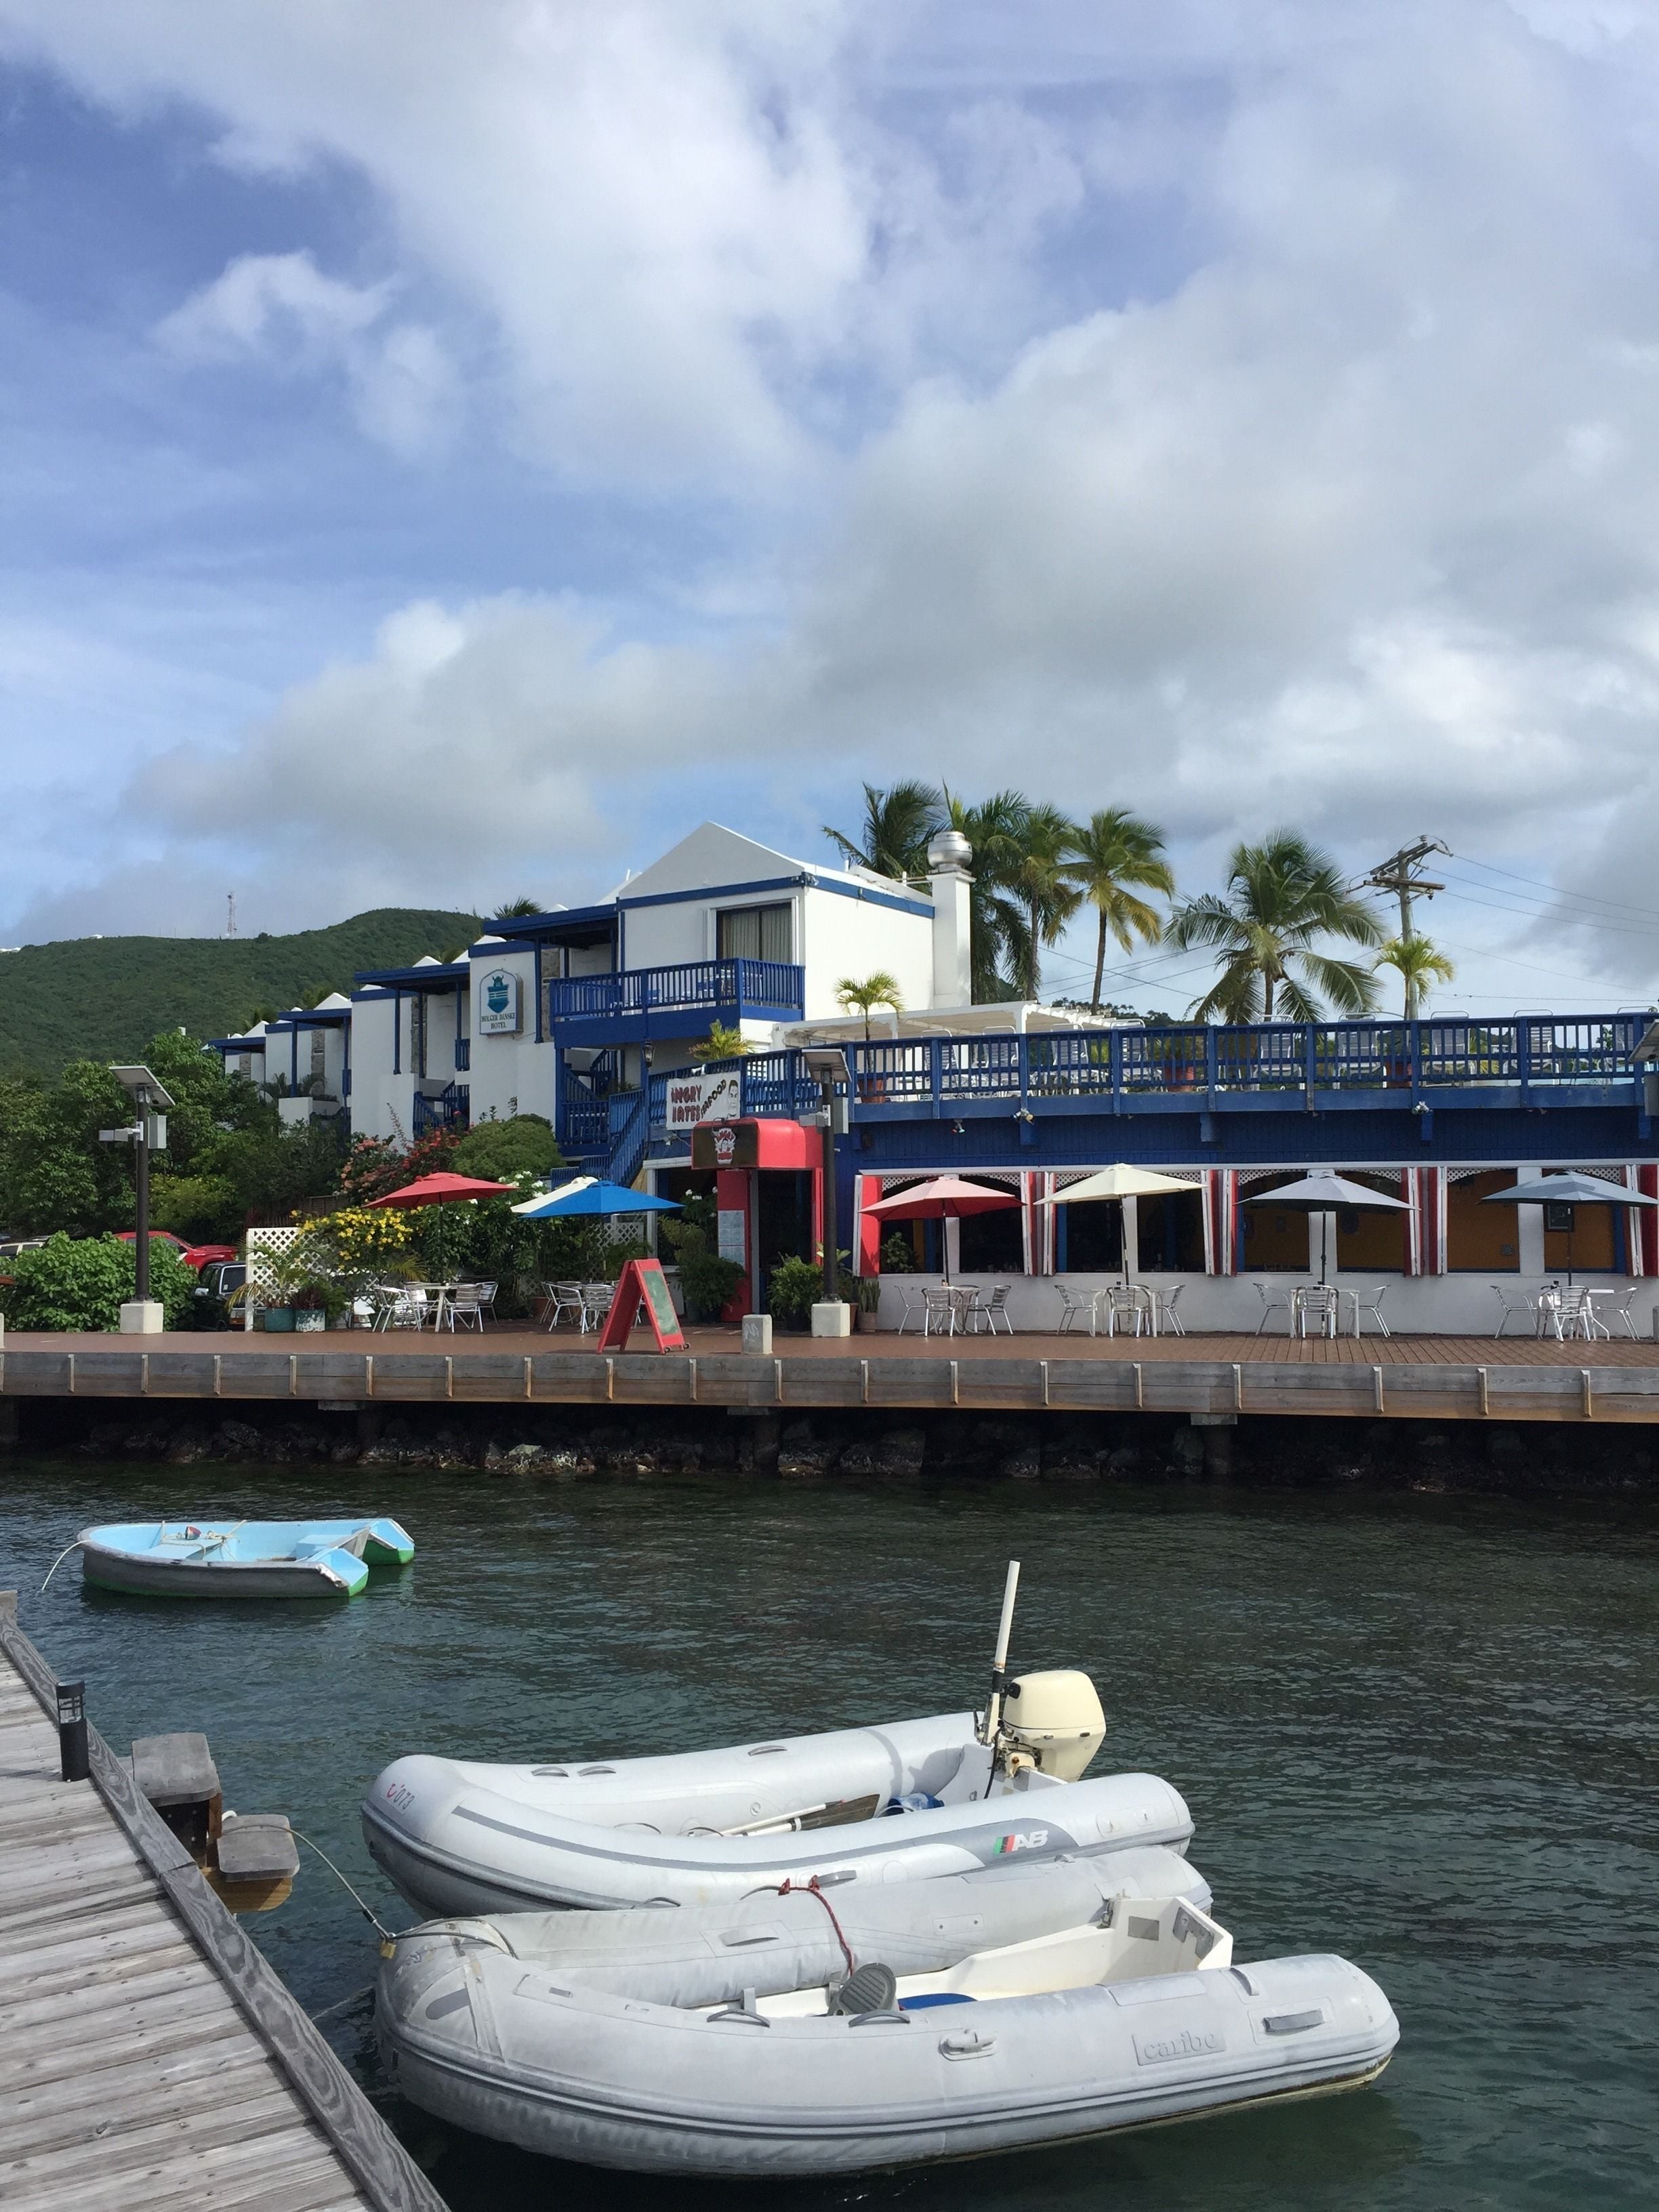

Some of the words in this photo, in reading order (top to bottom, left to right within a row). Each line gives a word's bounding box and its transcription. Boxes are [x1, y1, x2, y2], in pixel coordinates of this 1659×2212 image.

[491, 1021, 506, 1029] HOTEL
[672, 1084, 701, 1103] ANGRY
[701, 1079, 726, 1119] SEAFOOD
[1011, 1829, 1048, 1851] AB
[1143, 2030, 1216, 2060] caribe
